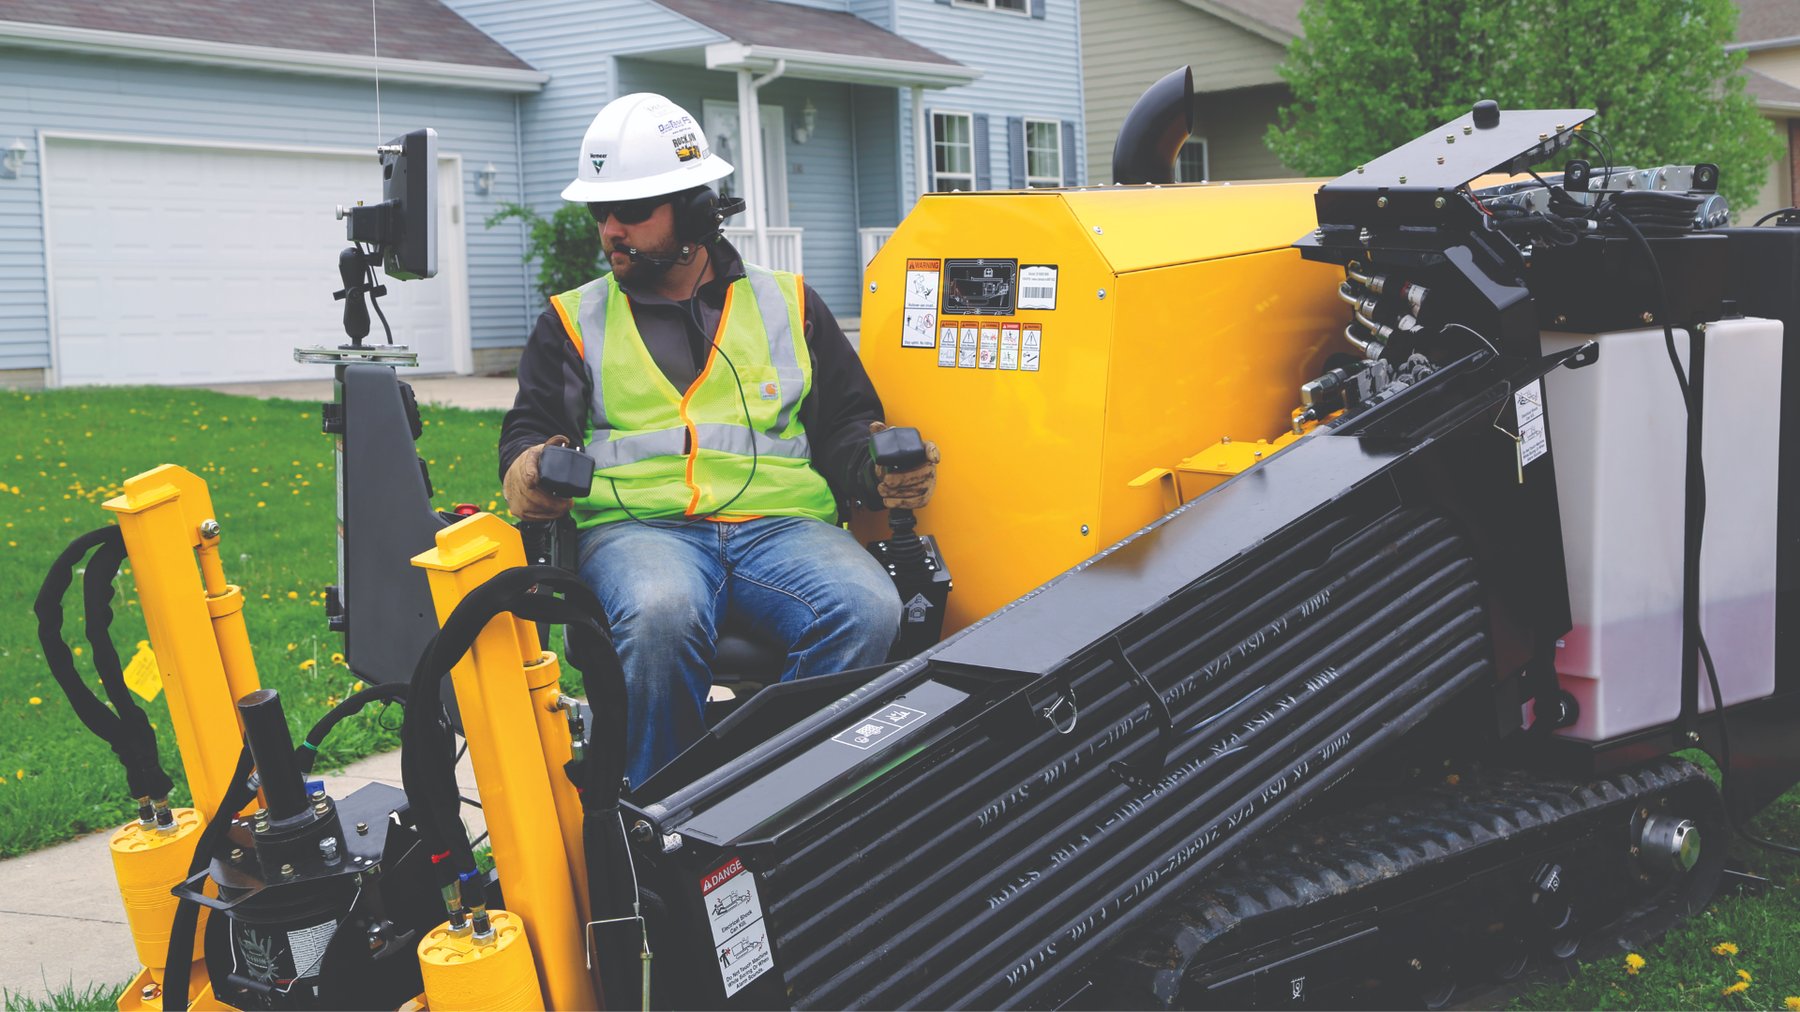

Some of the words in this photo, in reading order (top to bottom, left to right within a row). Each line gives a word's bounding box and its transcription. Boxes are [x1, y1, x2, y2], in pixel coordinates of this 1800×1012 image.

[711, 860, 743, 886] DANGE
[722, 917, 739, 933] Electrical
[740, 910, 752, 921] Shock
[740, 962, 751, 974] Touch
[752, 951, 768, 964] Machine
